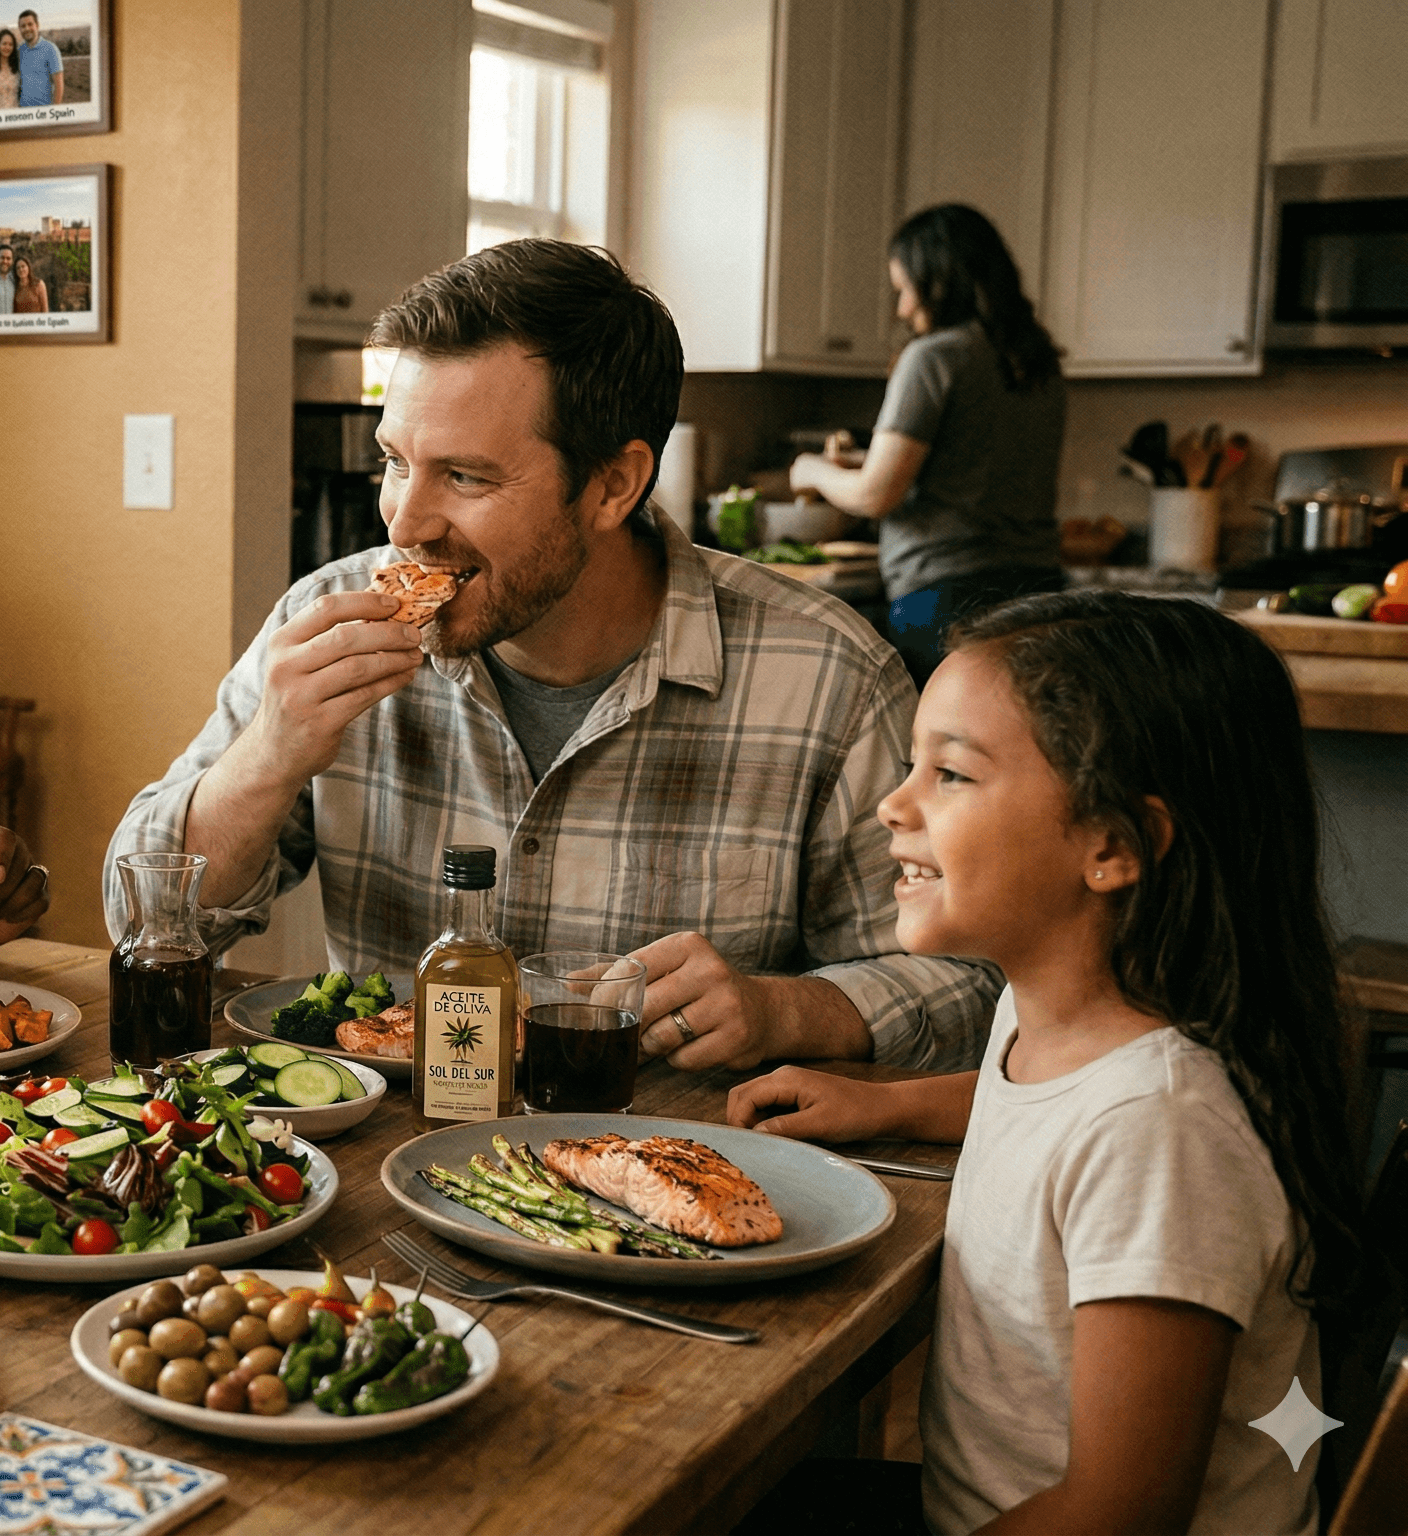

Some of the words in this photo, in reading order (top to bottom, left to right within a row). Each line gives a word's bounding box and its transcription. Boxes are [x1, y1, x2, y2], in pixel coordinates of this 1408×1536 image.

[440, 991, 485, 1003] ACEITE
[434, 1001, 450, 1012] DE
[453, 1003, 492, 1015] OLIVA
[429, 1065, 448, 1078] SOL
[451, 1067, 471, 1079] DEL
[474, 1068, 495, 1080] SUR
